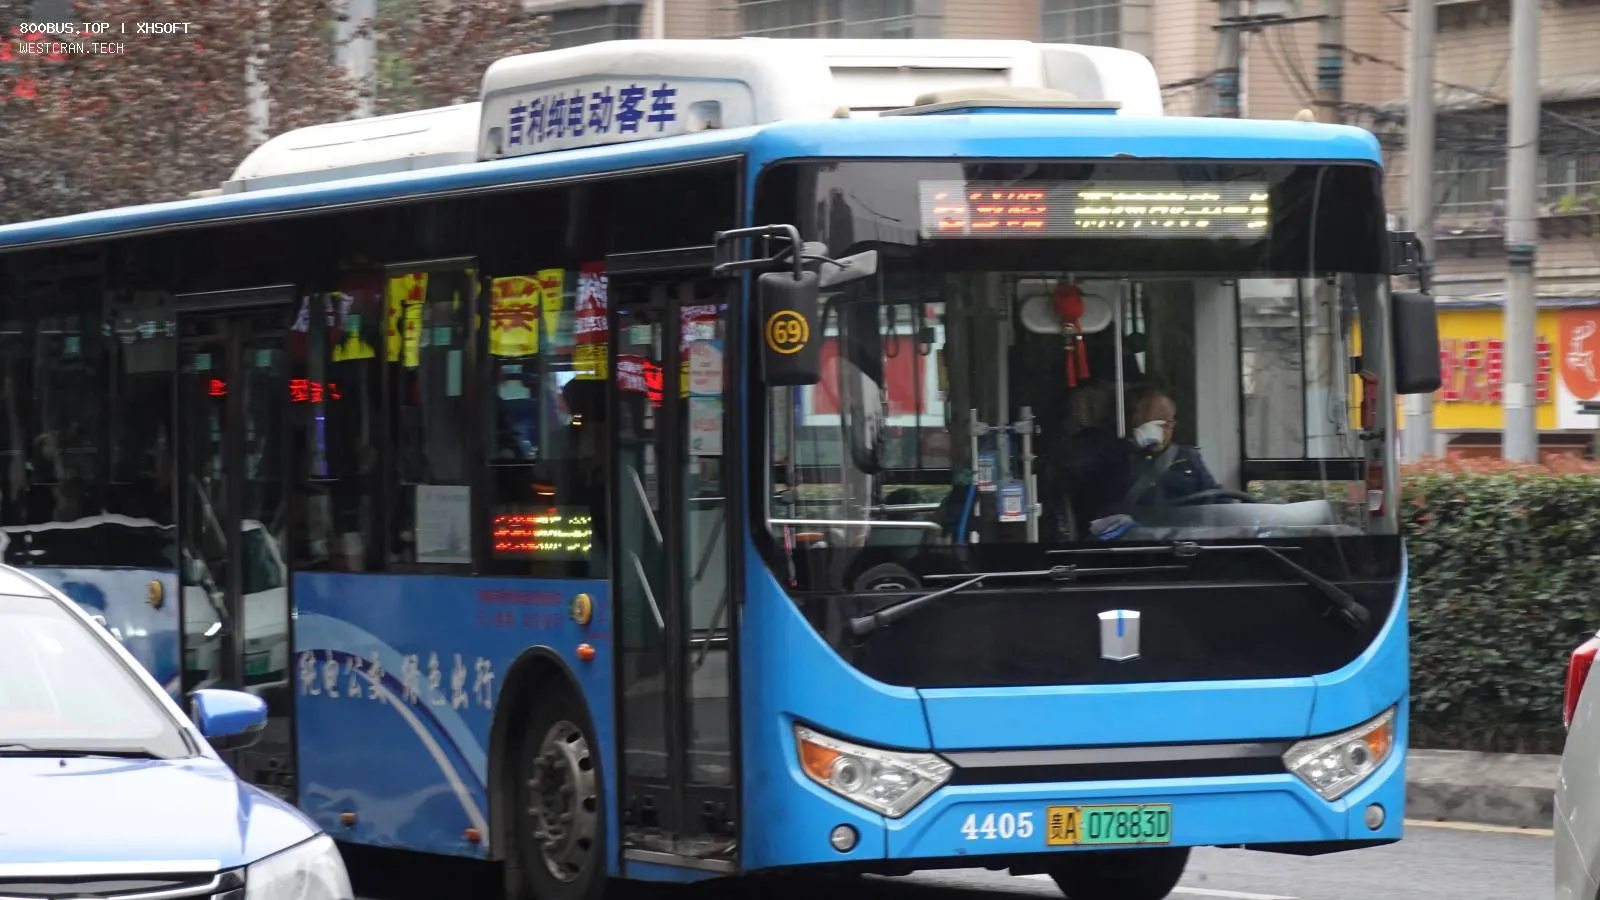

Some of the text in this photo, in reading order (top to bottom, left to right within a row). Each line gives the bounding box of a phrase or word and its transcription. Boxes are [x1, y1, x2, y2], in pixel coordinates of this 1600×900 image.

[508, 82, 677, 147] 吉利纯电动客车
[773, 320, 801, 344] 69
[961, 811, 1034, 840] 4405
